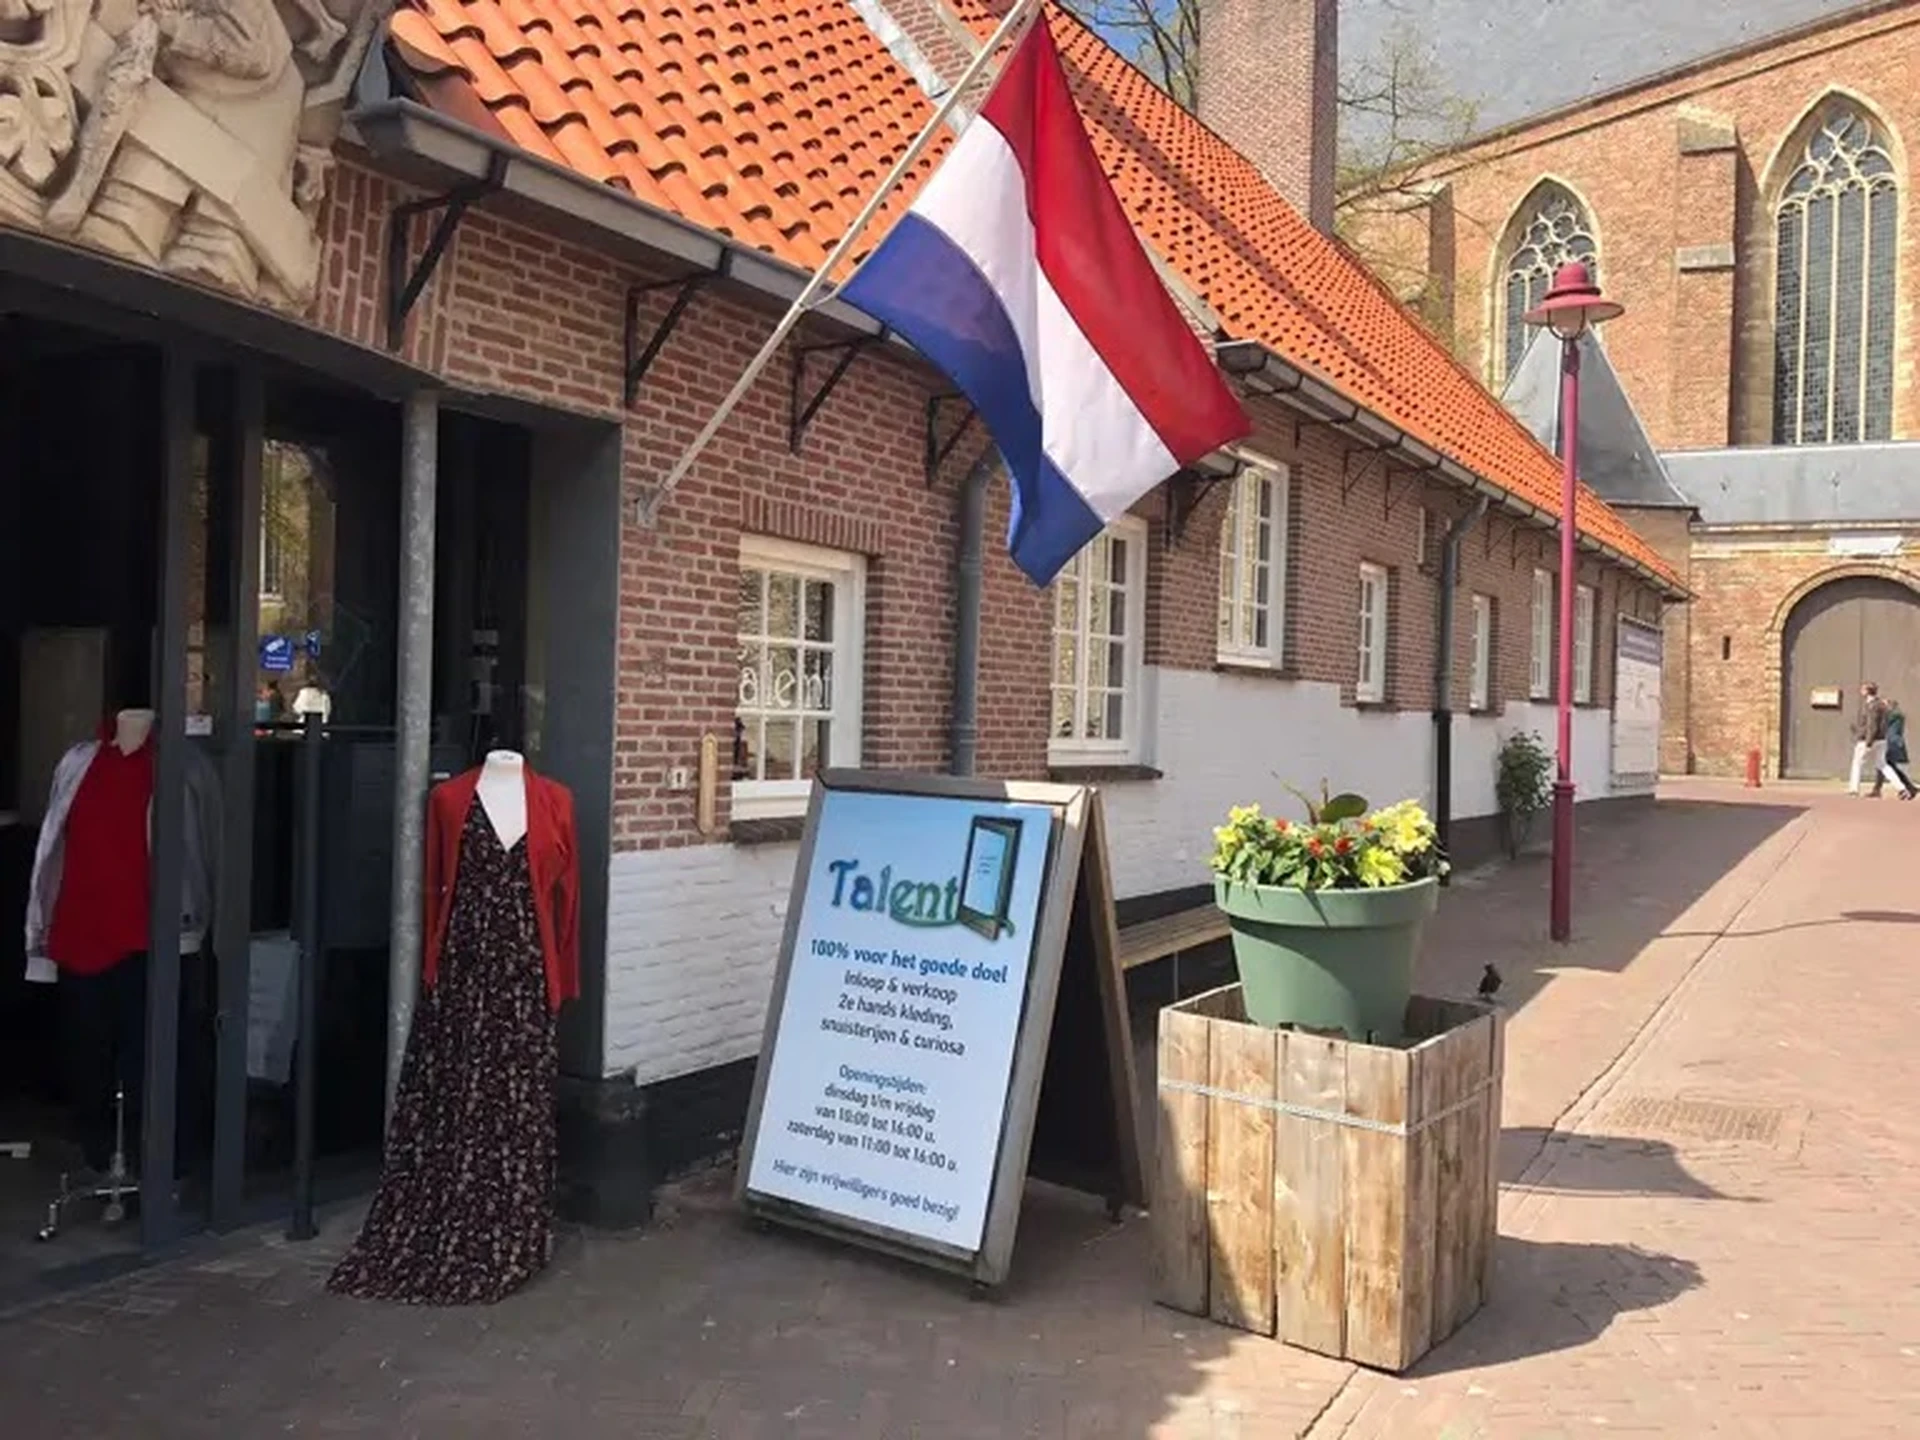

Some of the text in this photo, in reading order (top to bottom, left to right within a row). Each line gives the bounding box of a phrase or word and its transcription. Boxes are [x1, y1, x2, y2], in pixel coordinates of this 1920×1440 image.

[829, 858, 958, 921] Talent
[811, 939, 1009, 983] 100% voor het goede doel
[844, 970, 958, 1005] Inloop & verkoop
[838, 993, 953, 1030] 2e hands kleding,
[819, 1017, 965, 1056] snuisterijen & curiosa
[839, 1064, 927, 1095] Openingstijden:
[824, 1083, 936, 1122] dinsdag t/m vrijdag
[786, 1119, 836, 1145] zaterdag
[837, 1131, 859, 1147] van
[861, 1134, 891, 1155] 11:00
[893, 1143, 911, 1160] tot
[914, 1147, 946, 1168] 16:00
[815, 1105, 936, 1144] van 10:00 tot 16:00 u.
[773, 1158, 960, 1223] Hier zijn vrijwilligers goed bezig!
